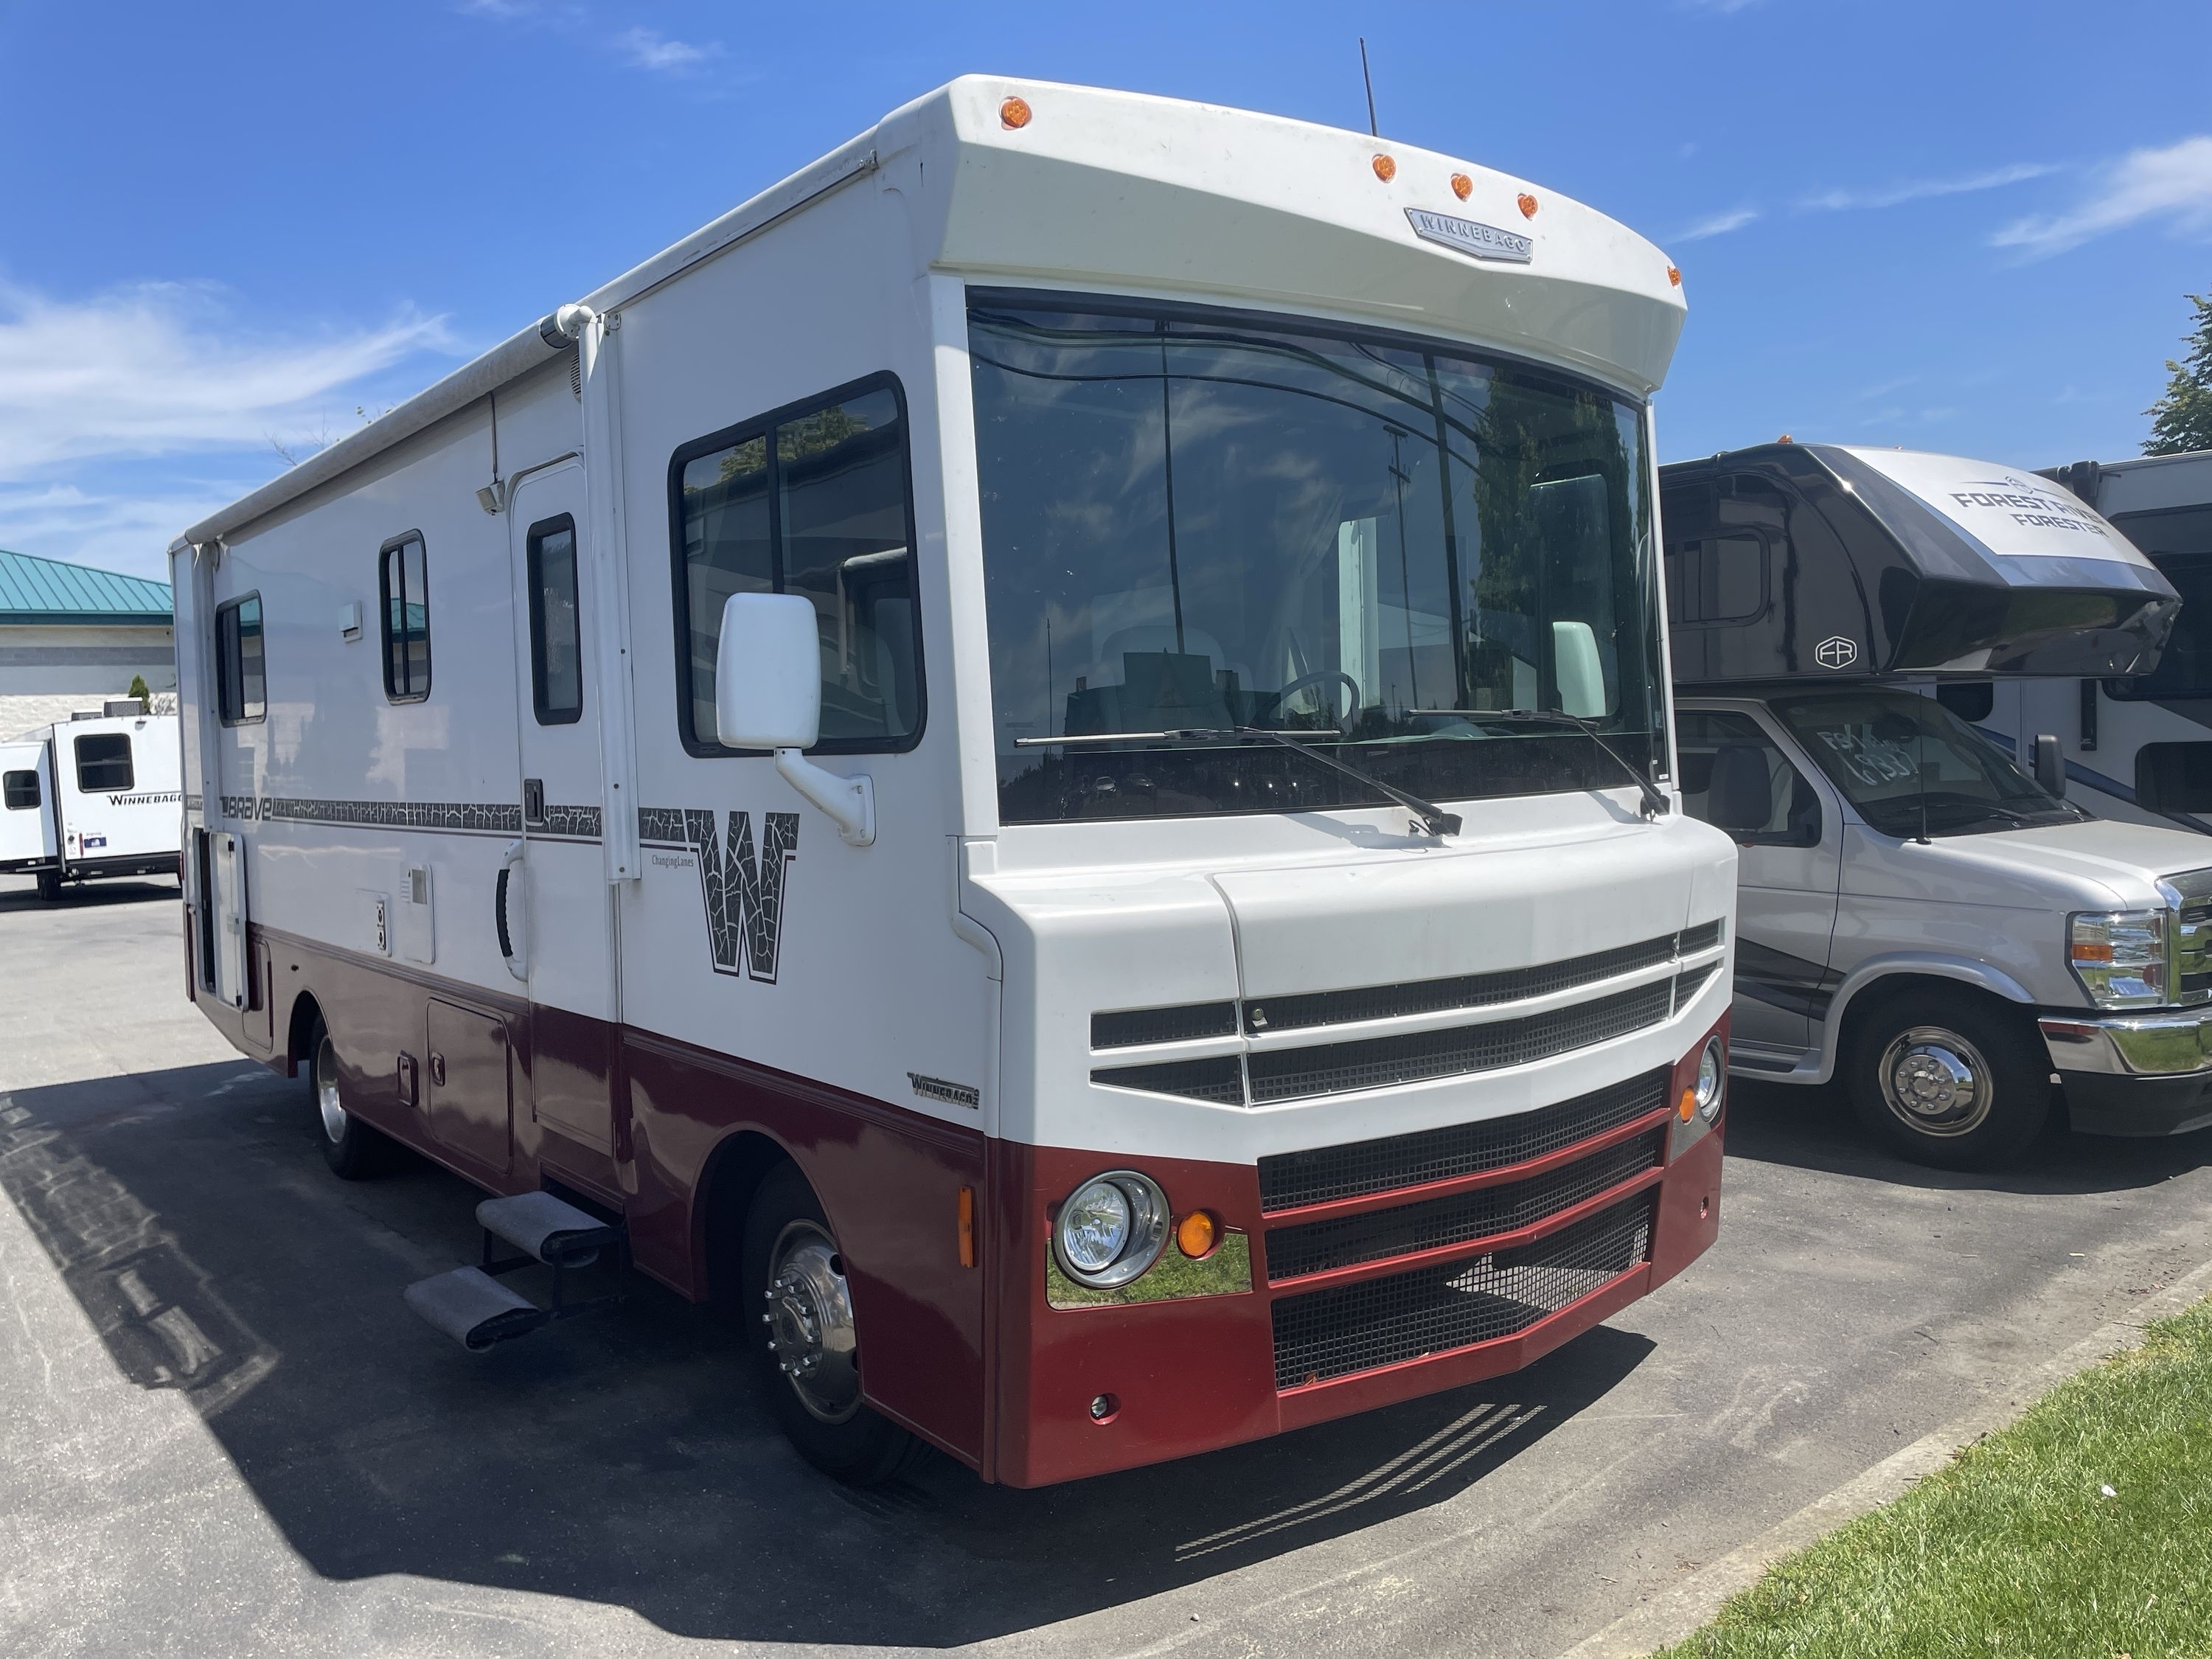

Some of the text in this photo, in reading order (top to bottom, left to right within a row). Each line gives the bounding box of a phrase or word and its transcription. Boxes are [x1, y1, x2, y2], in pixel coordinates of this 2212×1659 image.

[1420, 213, 1526, 252] WINNEBAGO
[1949, 493, 2052, 511] FOREST
[2008, 513, 2110, 538] FORESTER
[652, 855, 694, 869] ChangingLanes
[906, 1071, 973, 1108] WINNEBAGO
